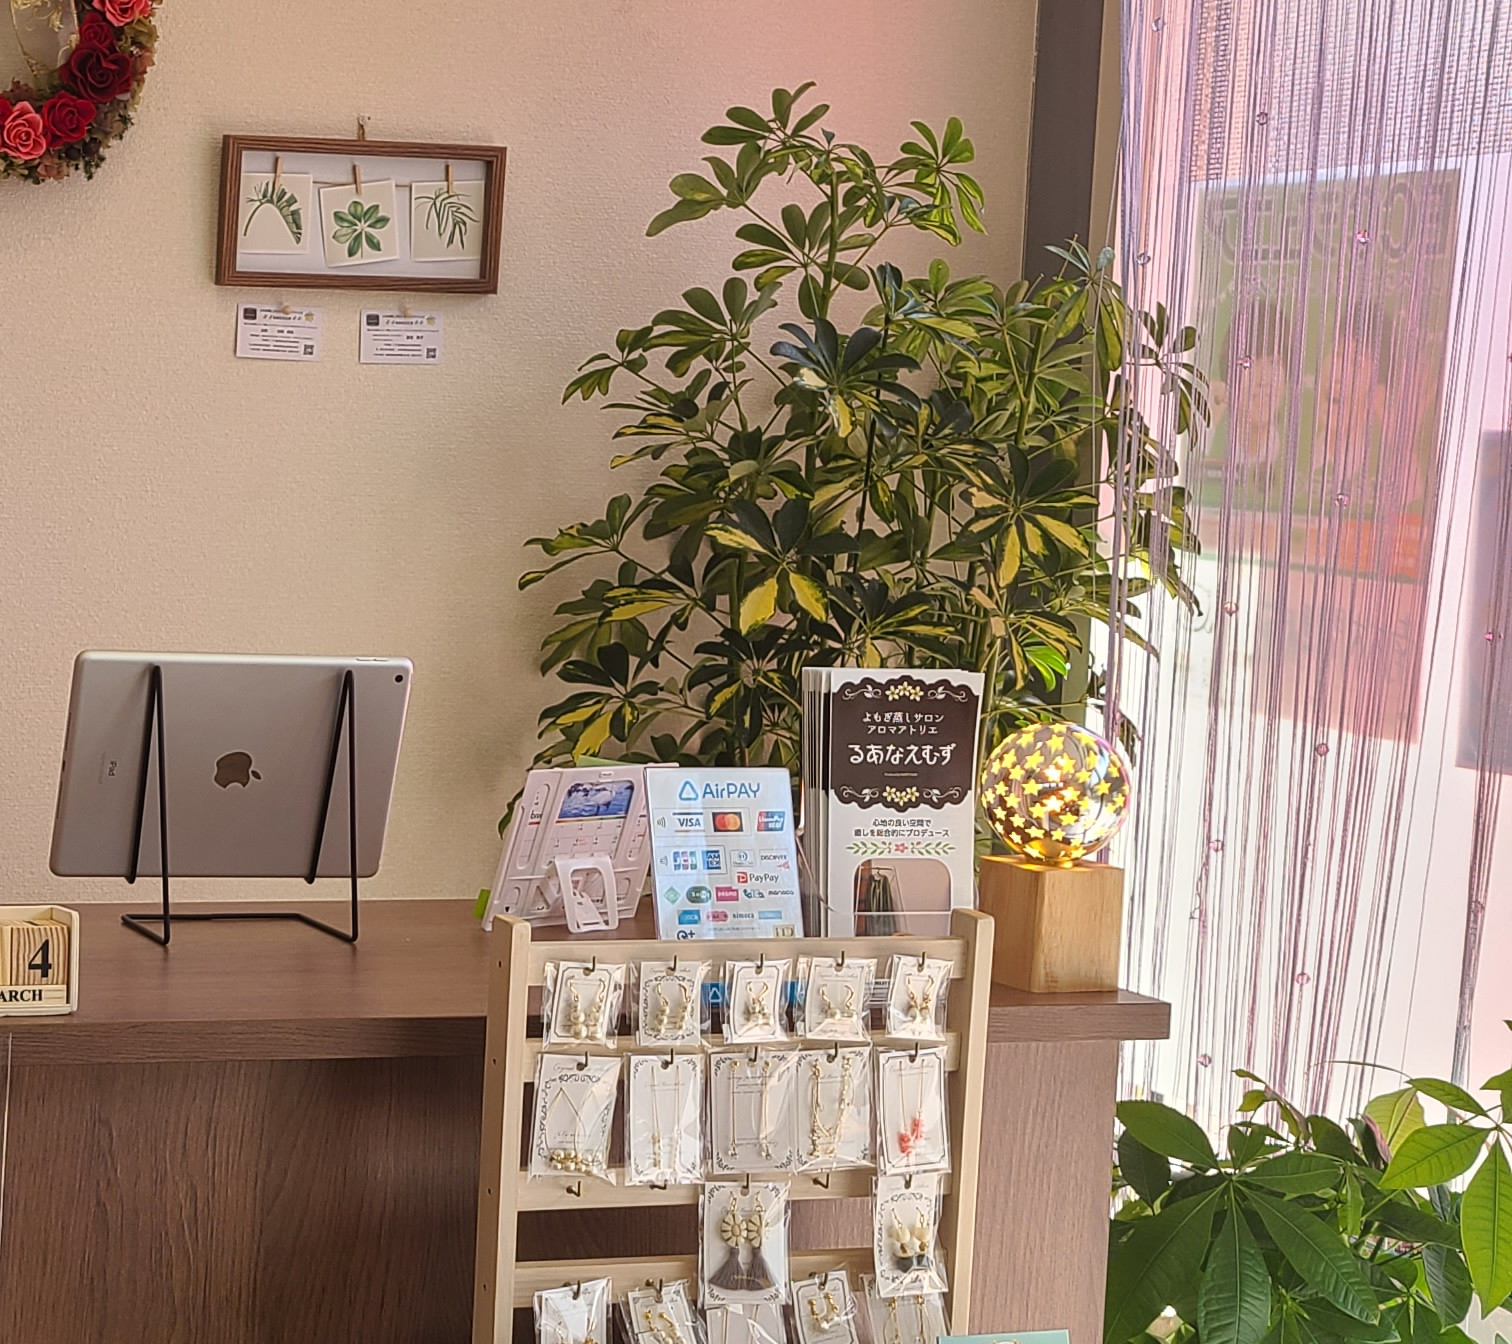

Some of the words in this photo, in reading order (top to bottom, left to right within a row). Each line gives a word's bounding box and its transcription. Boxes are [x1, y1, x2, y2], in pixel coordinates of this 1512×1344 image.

[862, 711, 944, 723] よもぎ蒸しサロン
[867, 725, 938, 735] アロマアトリエ
[848, 743, 957, 766] るあなえむず
[108, 760, 117, 776] iPad
[702, 783, 760, 799] AirPAY
[677, 817, 701, 827] VISA
[873, 819, 932, 827] 心地の良い空間で
[854, 828, 950, 838] 癒しを総合的にプロデュース
[750, 873, 779, 883] PayPay
[28, 938, 52, 978] 4
